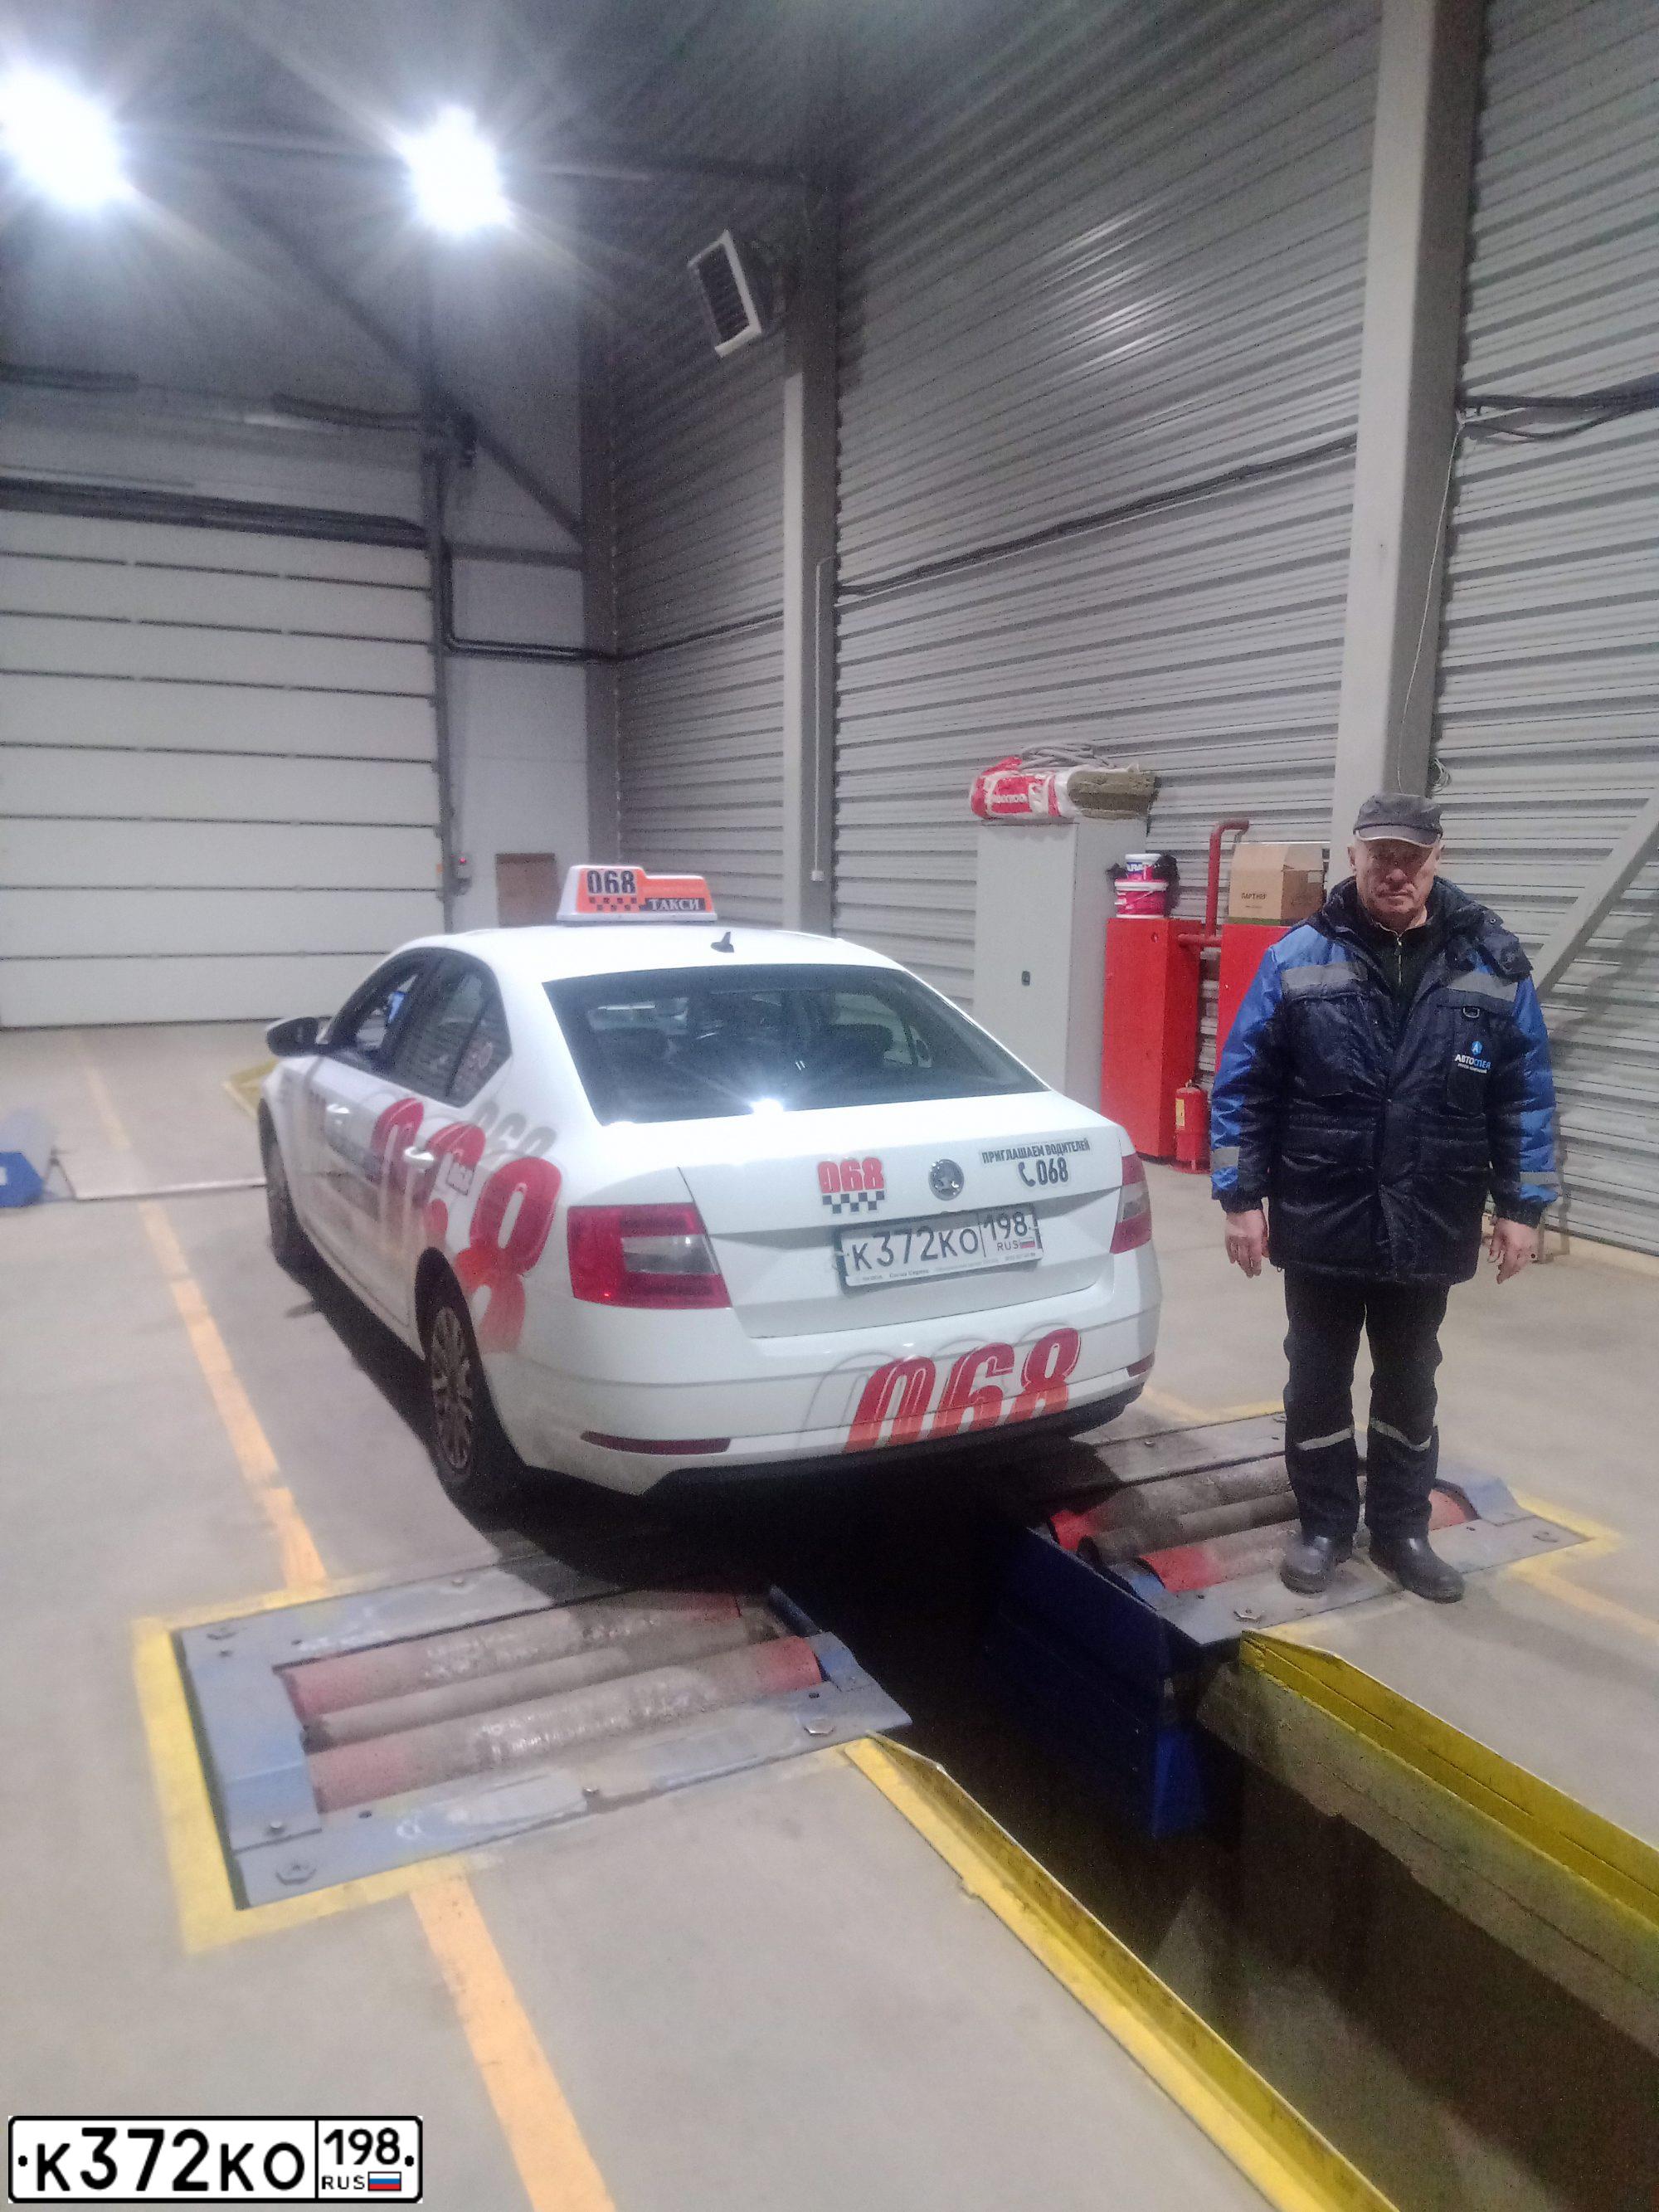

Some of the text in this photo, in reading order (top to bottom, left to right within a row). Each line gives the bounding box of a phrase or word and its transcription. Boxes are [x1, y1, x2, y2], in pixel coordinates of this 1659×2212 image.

[586, 870, 636, 894] 068
[649, 898, 700, 911] ТАКСИ
[981, 1138, 1091, 1163] ПРИГЛАШАЕМ ВОДИТЕЛЕЙ
[817, 1157, 885, 1194] 068
[1035, 1157, 1069, 1186] 068
[983, 1211, 1028, 1241] 198
[996, 1240, 1019, 1252] RUS
[841, 1327, 1081, 1454] 068
